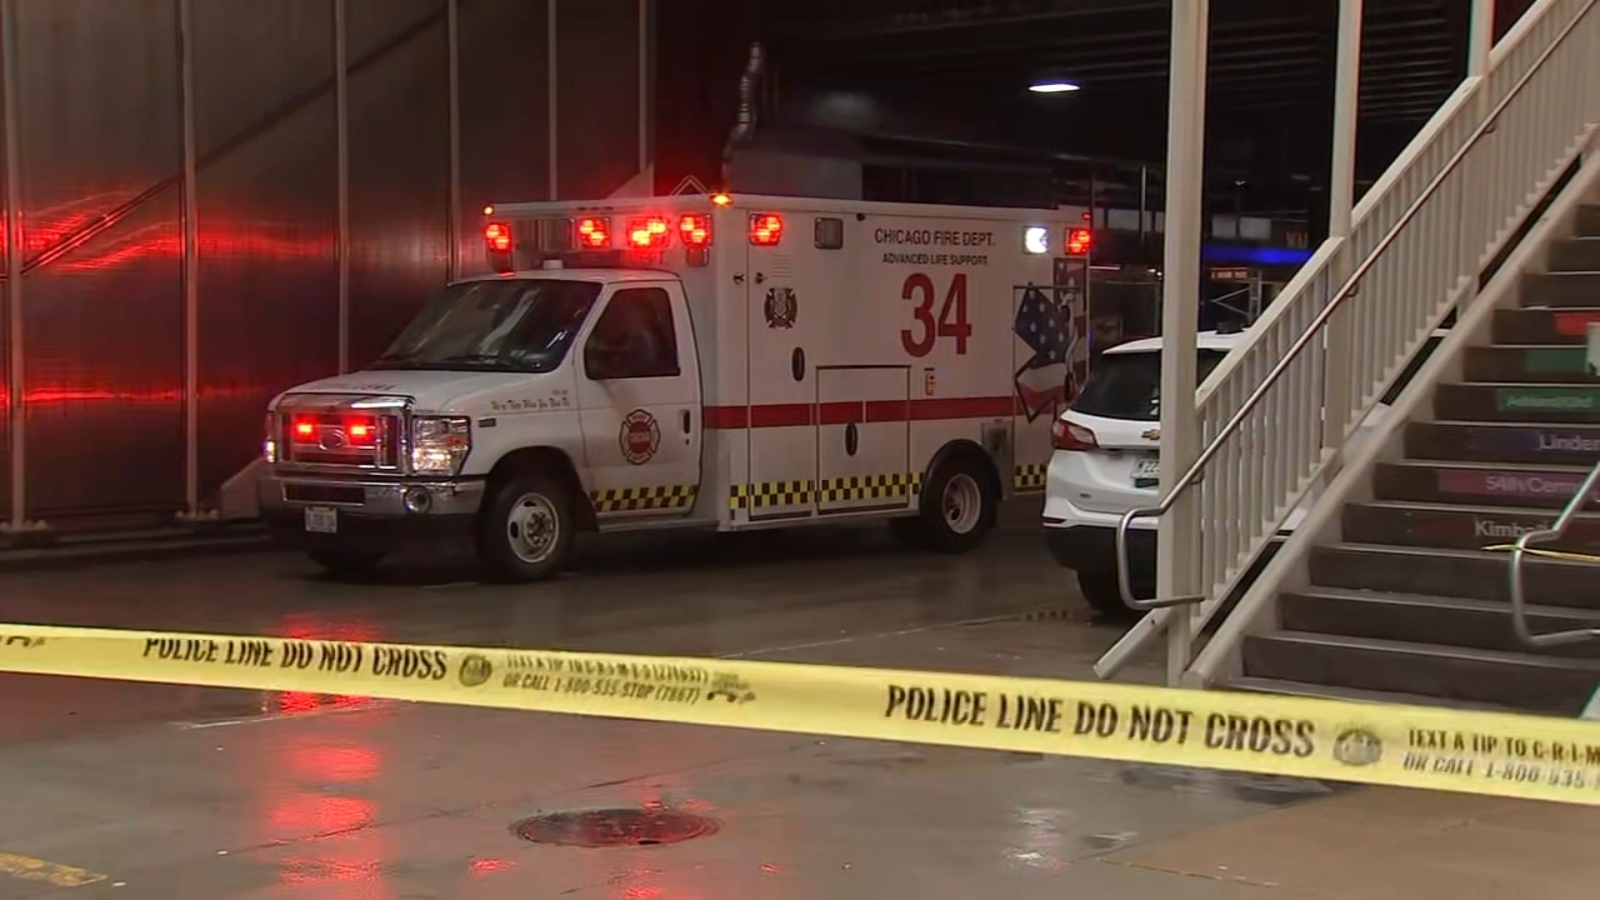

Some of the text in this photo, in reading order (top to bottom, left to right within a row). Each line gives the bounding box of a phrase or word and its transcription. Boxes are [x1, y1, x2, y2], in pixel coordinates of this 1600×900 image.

[874, 228, 996, 247] CHICAGO FIRE DEPT.
[882, 253, 988, 266] ADVANCED LIFE SUPPORT
[900, 272, 972, 358] 34
[143, 637, 447, 680] POLICE LINE DO NOT CROSS
[503, 672, 521, 688] OR
[522, 673, 550, 691] CALL
[885, 684, 1316, 758] POLICE LINE DO NOT CROSS
[1408, 728, 1448, 750] TEXT
[1452, 732, 1465, 751] A
[1473, 734, 1498, 754] TIP
[1505, 736, 1527, 758] TO
[1403, 752, 1426, 772] OR
[1432, 755, 1474, 777] CALL
